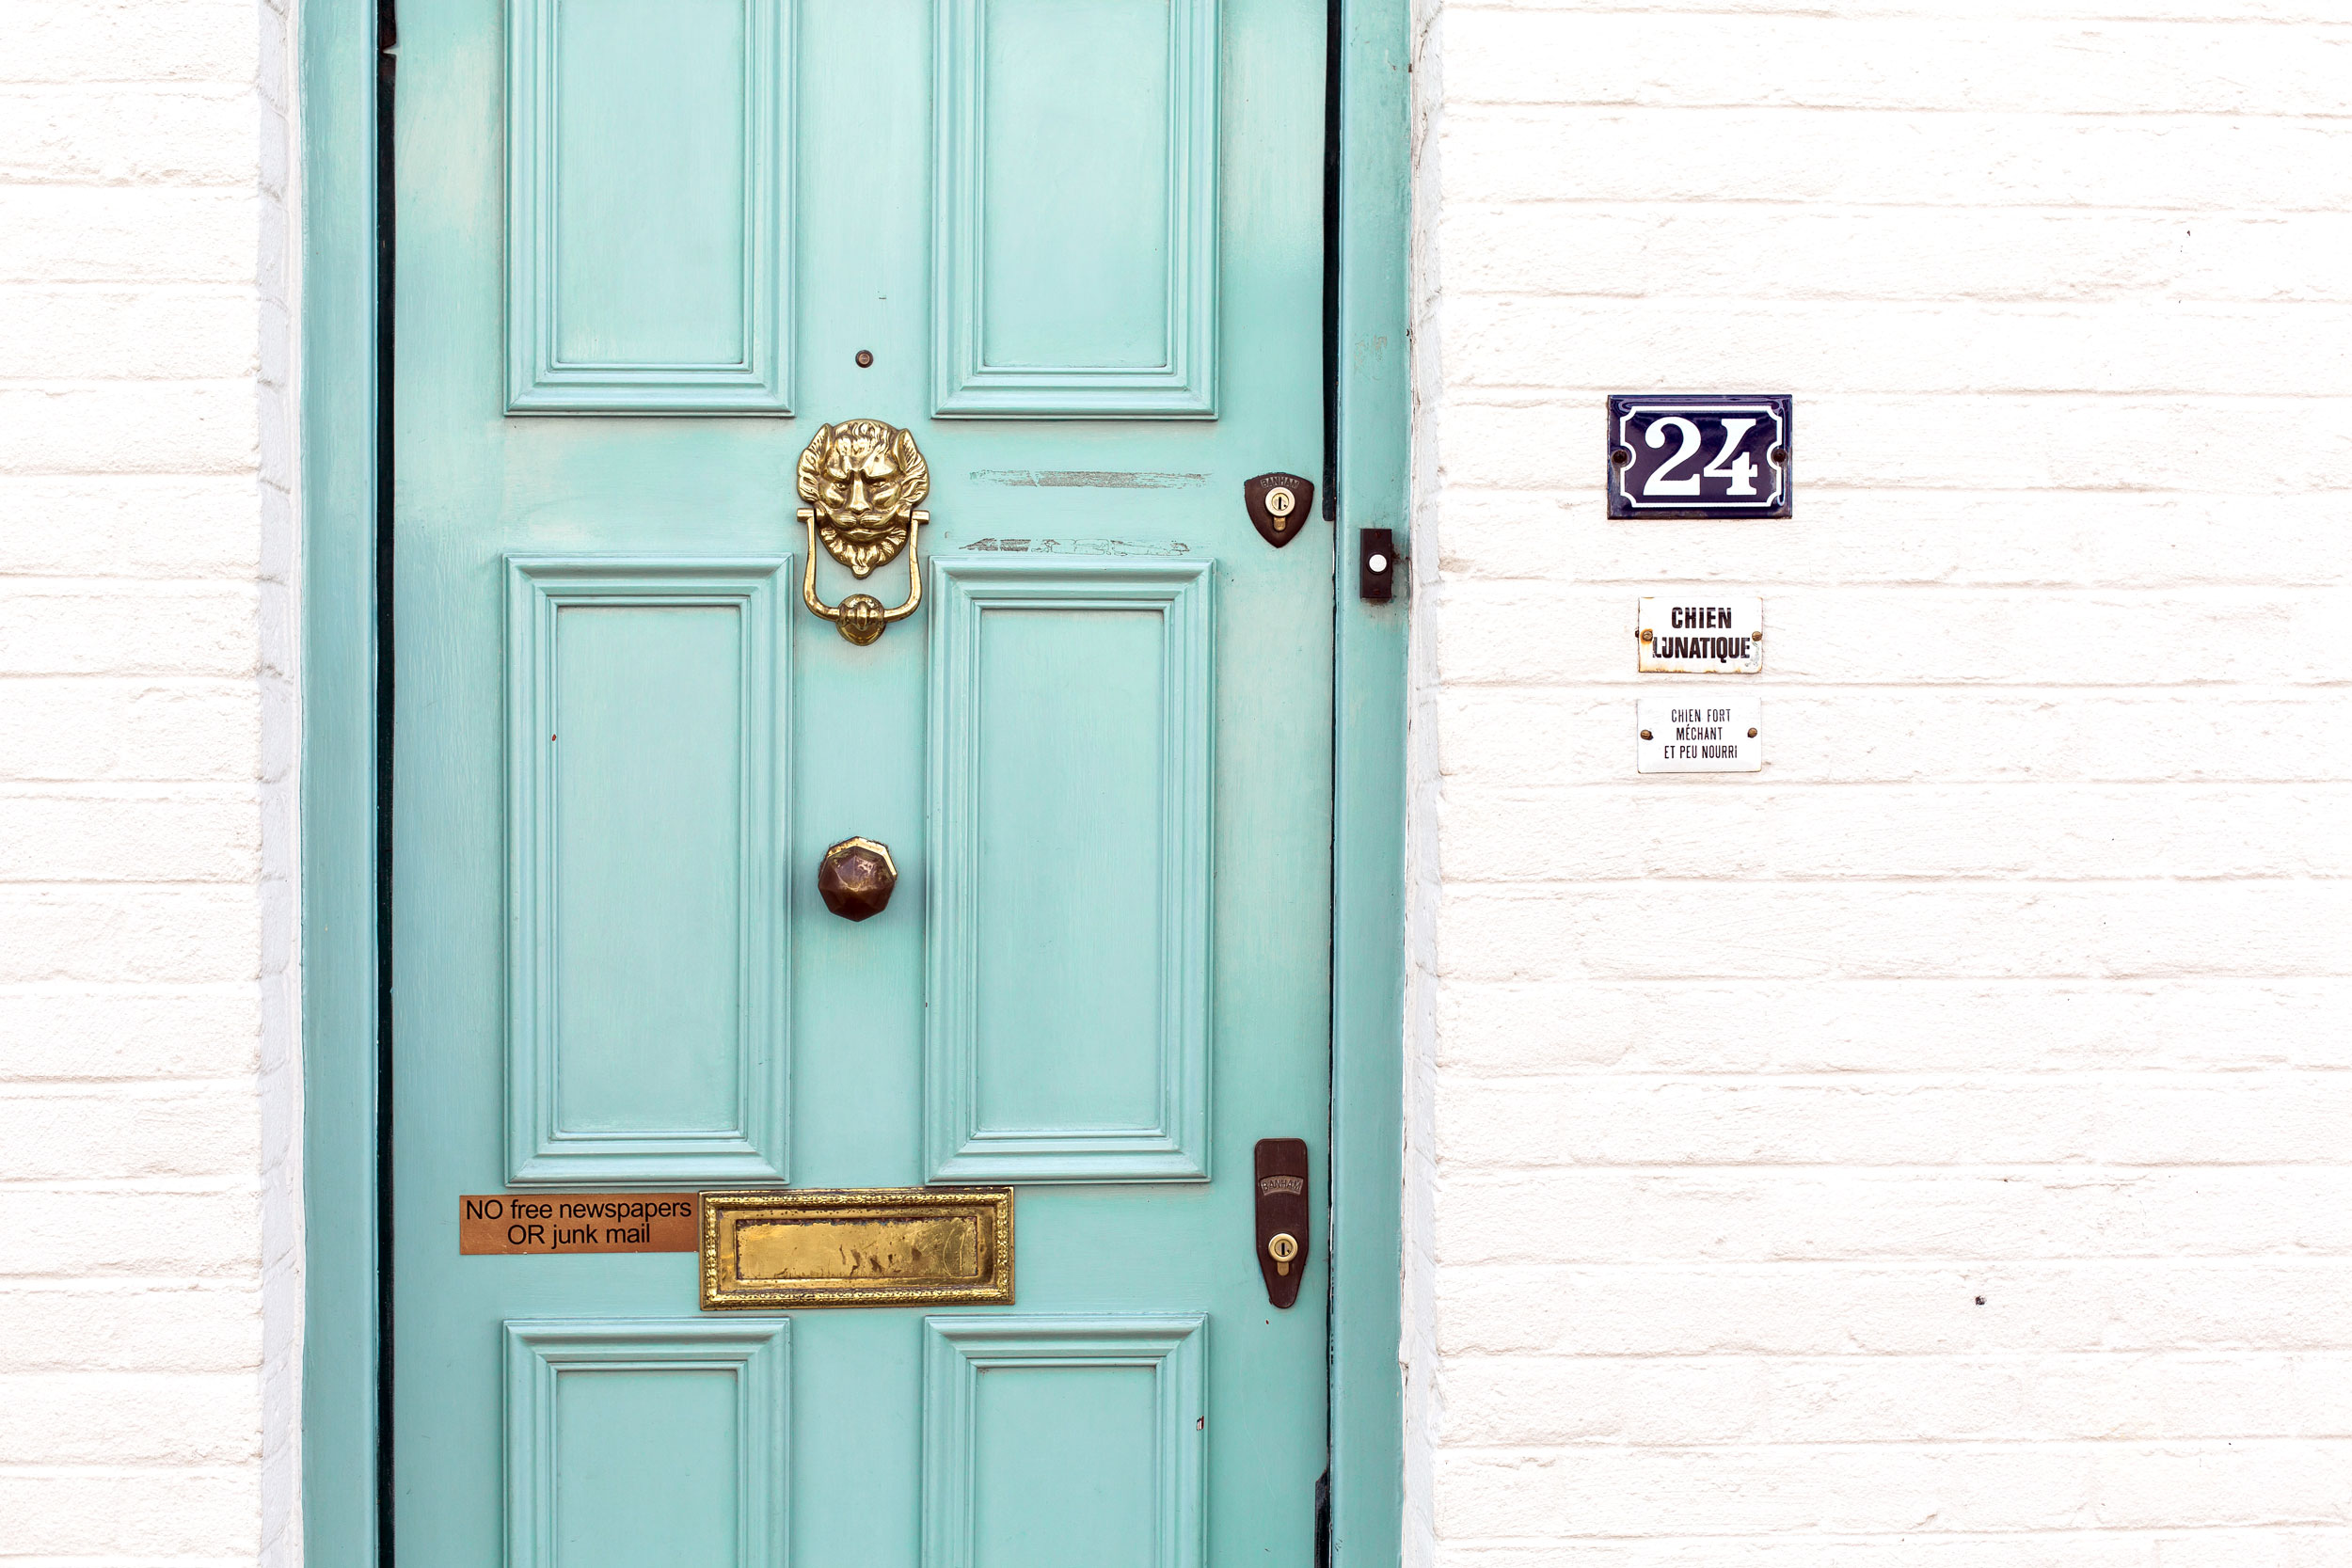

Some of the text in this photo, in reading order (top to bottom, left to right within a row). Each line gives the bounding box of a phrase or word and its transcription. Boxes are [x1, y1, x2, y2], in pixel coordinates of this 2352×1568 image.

[1643, 417, 1758, 496] 24
[1261, 476, 1299, 489] BANHAM
[1672, 607, 1732, 629] CHIEN
[1653, 637, 1750, 663] LUNATIQUE
[1671, 708, 1731, 722] CHIEN FORT
[1677, 724, 1723, 740] MÉCHANT
[1664, 745, 1676, 759] ET
[1679, 745, 1697, 759] PEU
[1262, 1179, 1301, 1192] BANHAM
[467, 1199, 691, 1223] NO free newspapers
[508, 1223, 650, 1249] OR junk mail
